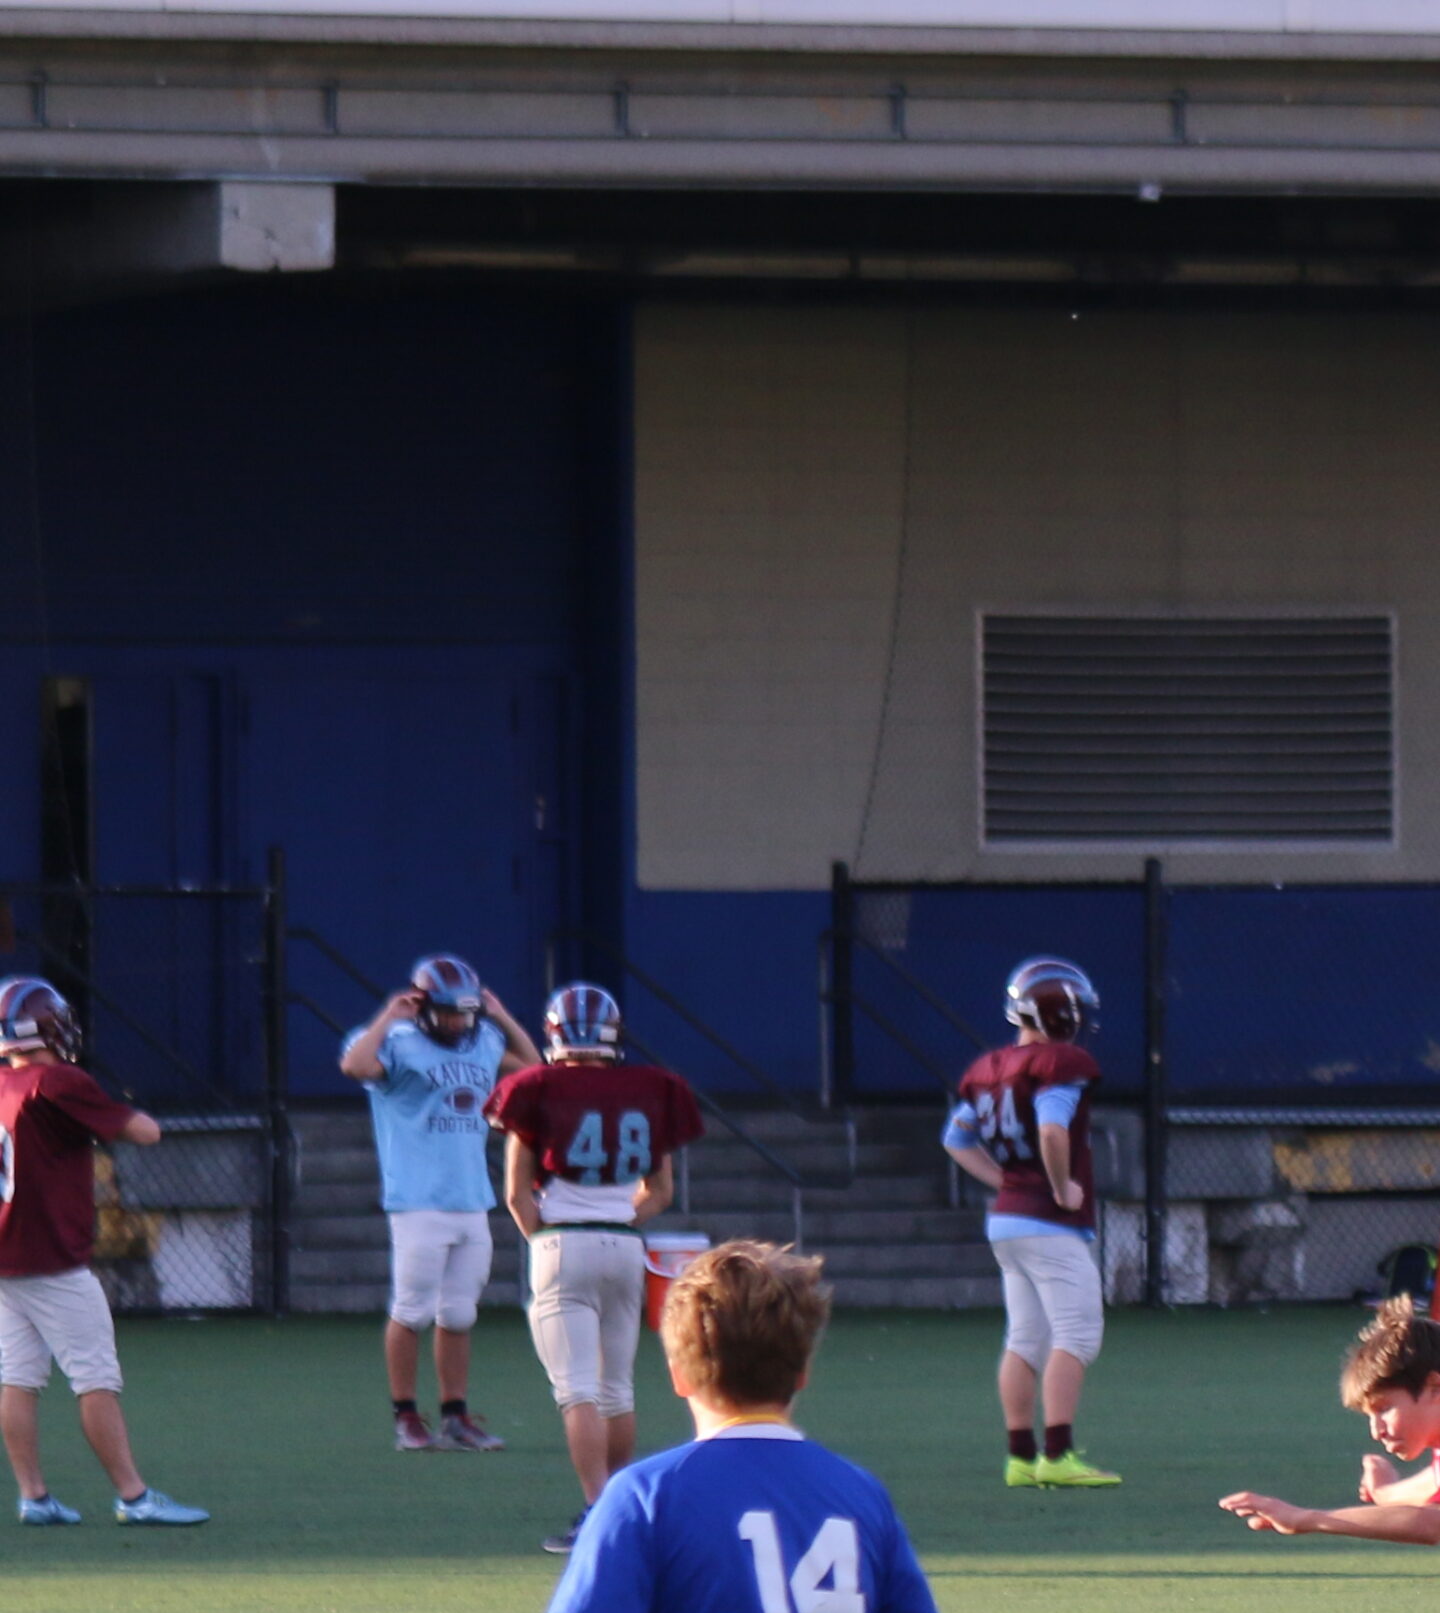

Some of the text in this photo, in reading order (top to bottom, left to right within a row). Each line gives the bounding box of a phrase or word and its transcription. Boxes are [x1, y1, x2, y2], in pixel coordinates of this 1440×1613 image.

[427, 1061, 492, 1097] XAVIER
[427, 1115, 481, 1135] FOOTBA
[566, 1110, 652, 1186] 48
